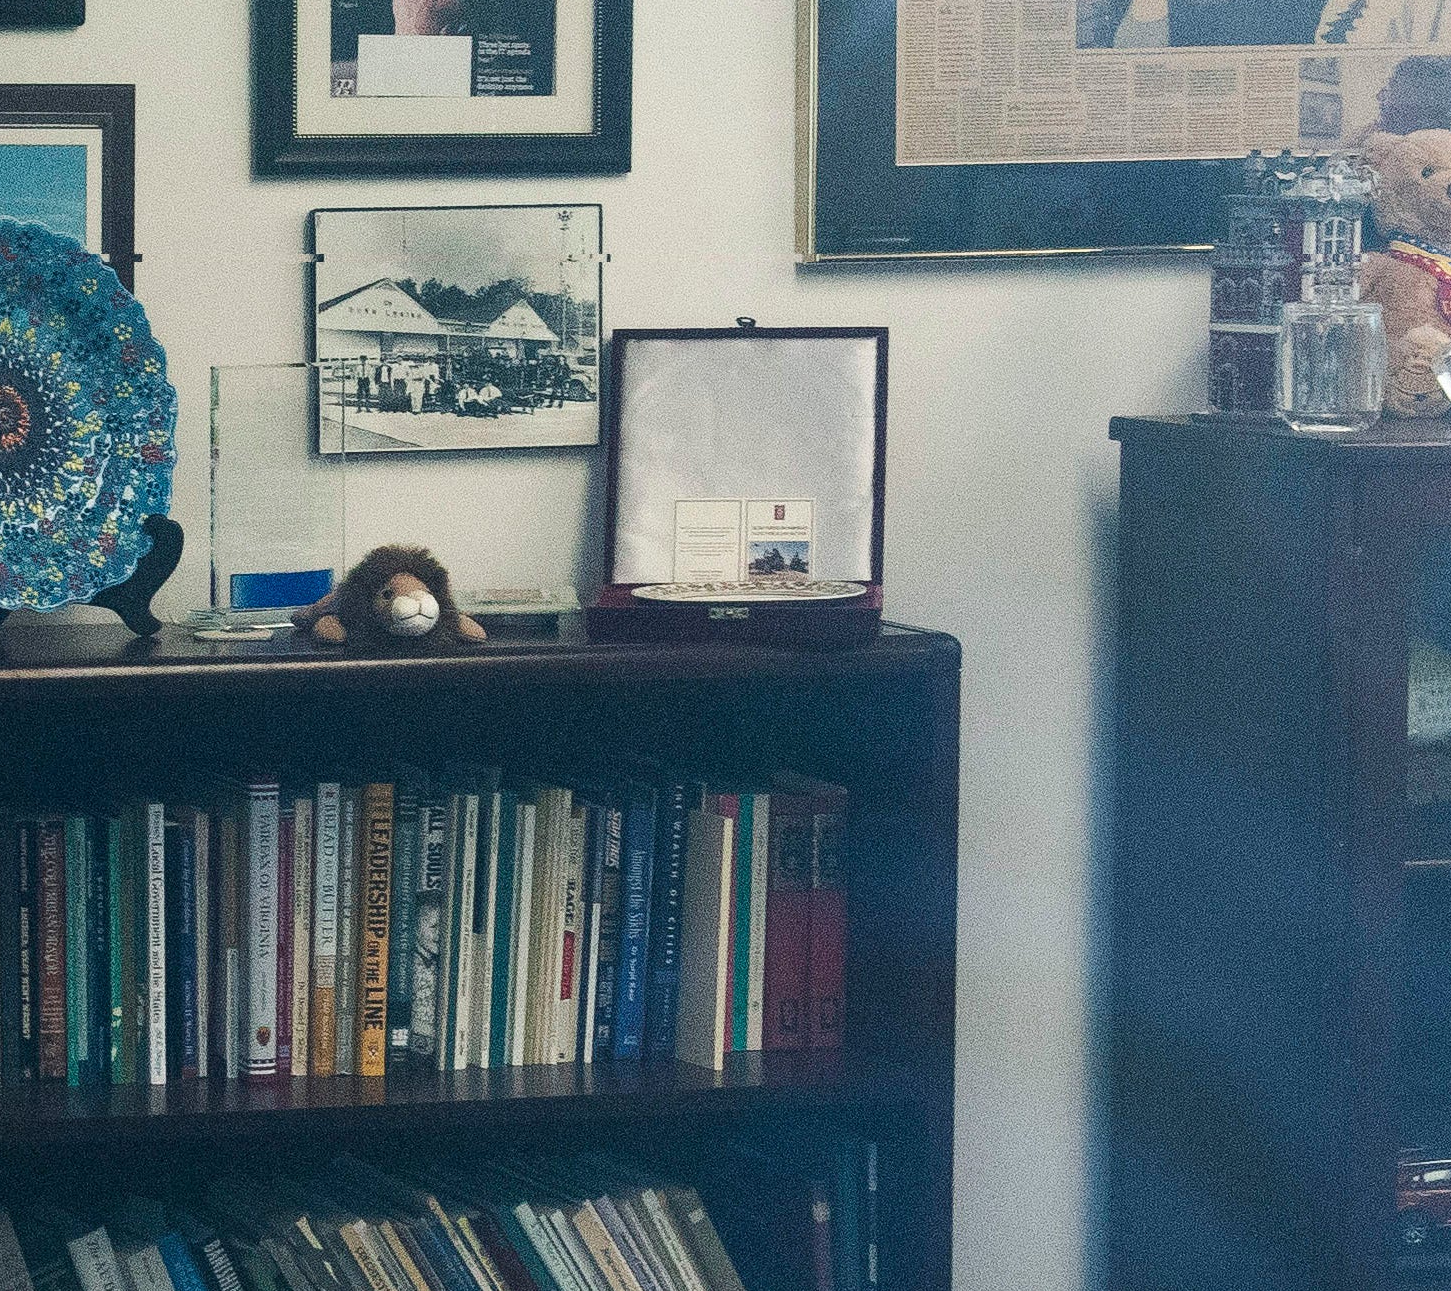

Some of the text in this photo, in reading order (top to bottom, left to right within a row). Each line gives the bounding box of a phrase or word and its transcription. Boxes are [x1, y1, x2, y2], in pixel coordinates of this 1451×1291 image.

[321, 803, 336, 947] BREAD AND BUTTER
[425, 807, 446, 890] ALL SOULS
[670, 820, 682, 880] WEALTH
[258, 813, 271, 959] FAIRFAX OF VIRGINIA
[629, 893, 645, 910] the
[668, 888, 679, 906] OF
[151, 842, 163, 1024] Local Government and the States
[363, 817, 391, 1032] LEADERSHIP ON THE LINE
[627, 912, 644, 939] Sikhs
[664, 916, 677, 966] CITIES
[84, 1238, 104, 1261] The
